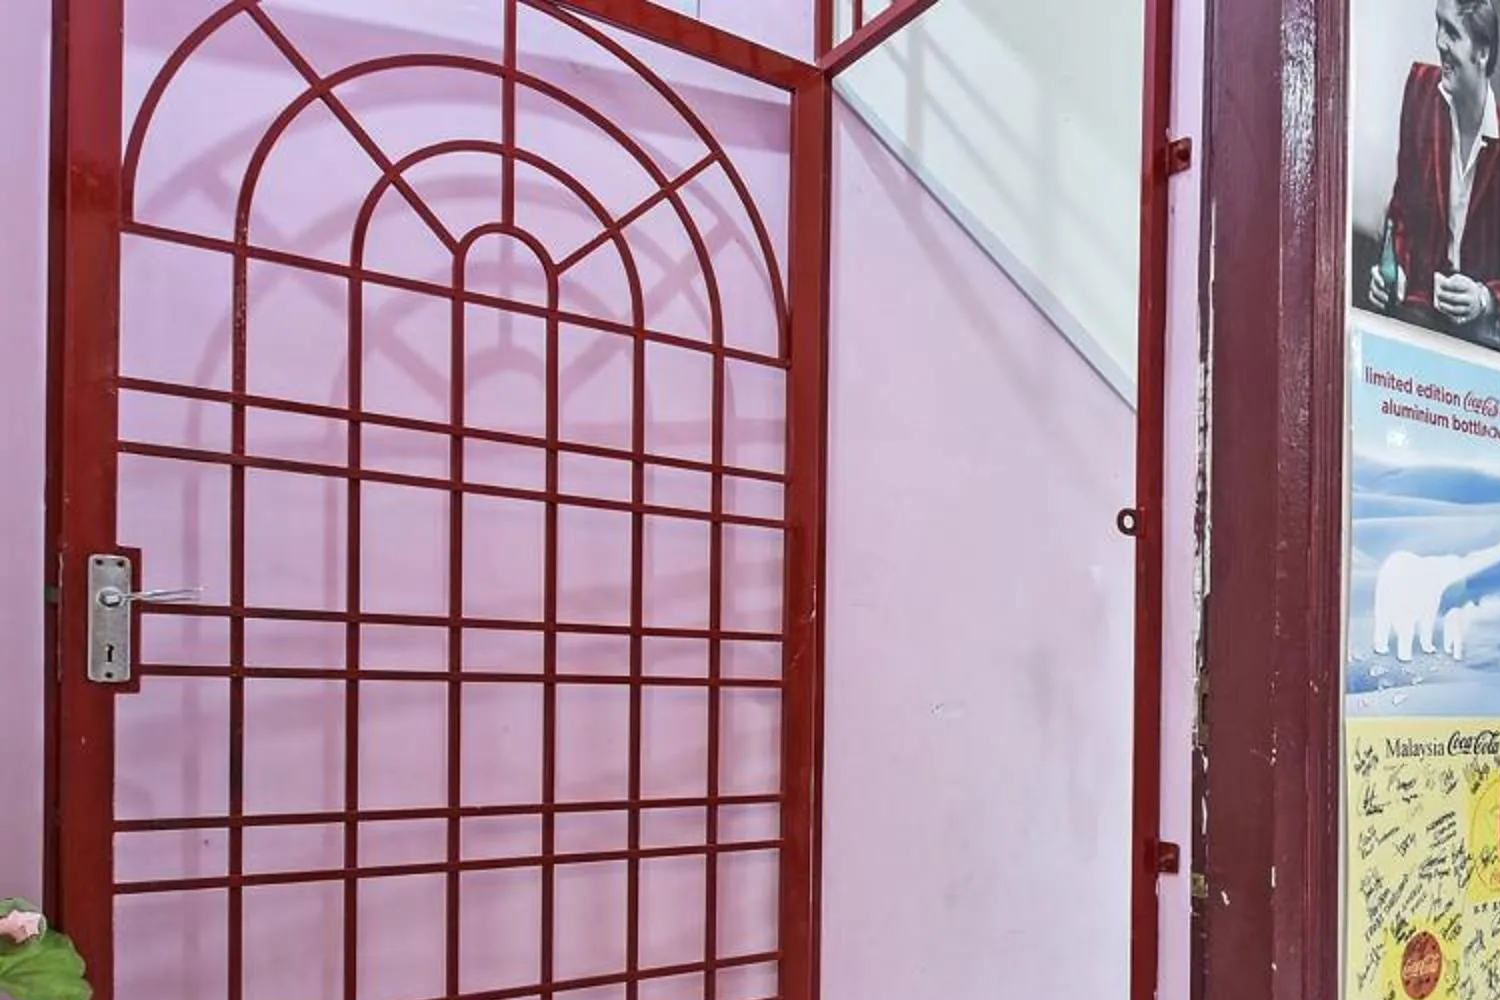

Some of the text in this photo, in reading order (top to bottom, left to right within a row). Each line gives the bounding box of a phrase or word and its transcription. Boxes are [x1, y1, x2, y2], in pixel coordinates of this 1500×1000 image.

[1364, 366, 1413, 394] limited
[1416, 384, 1461, 406] edition
[1381, 398, 1450, 429] aluminium
[1385, 737, 1445, 759] Malaysia
